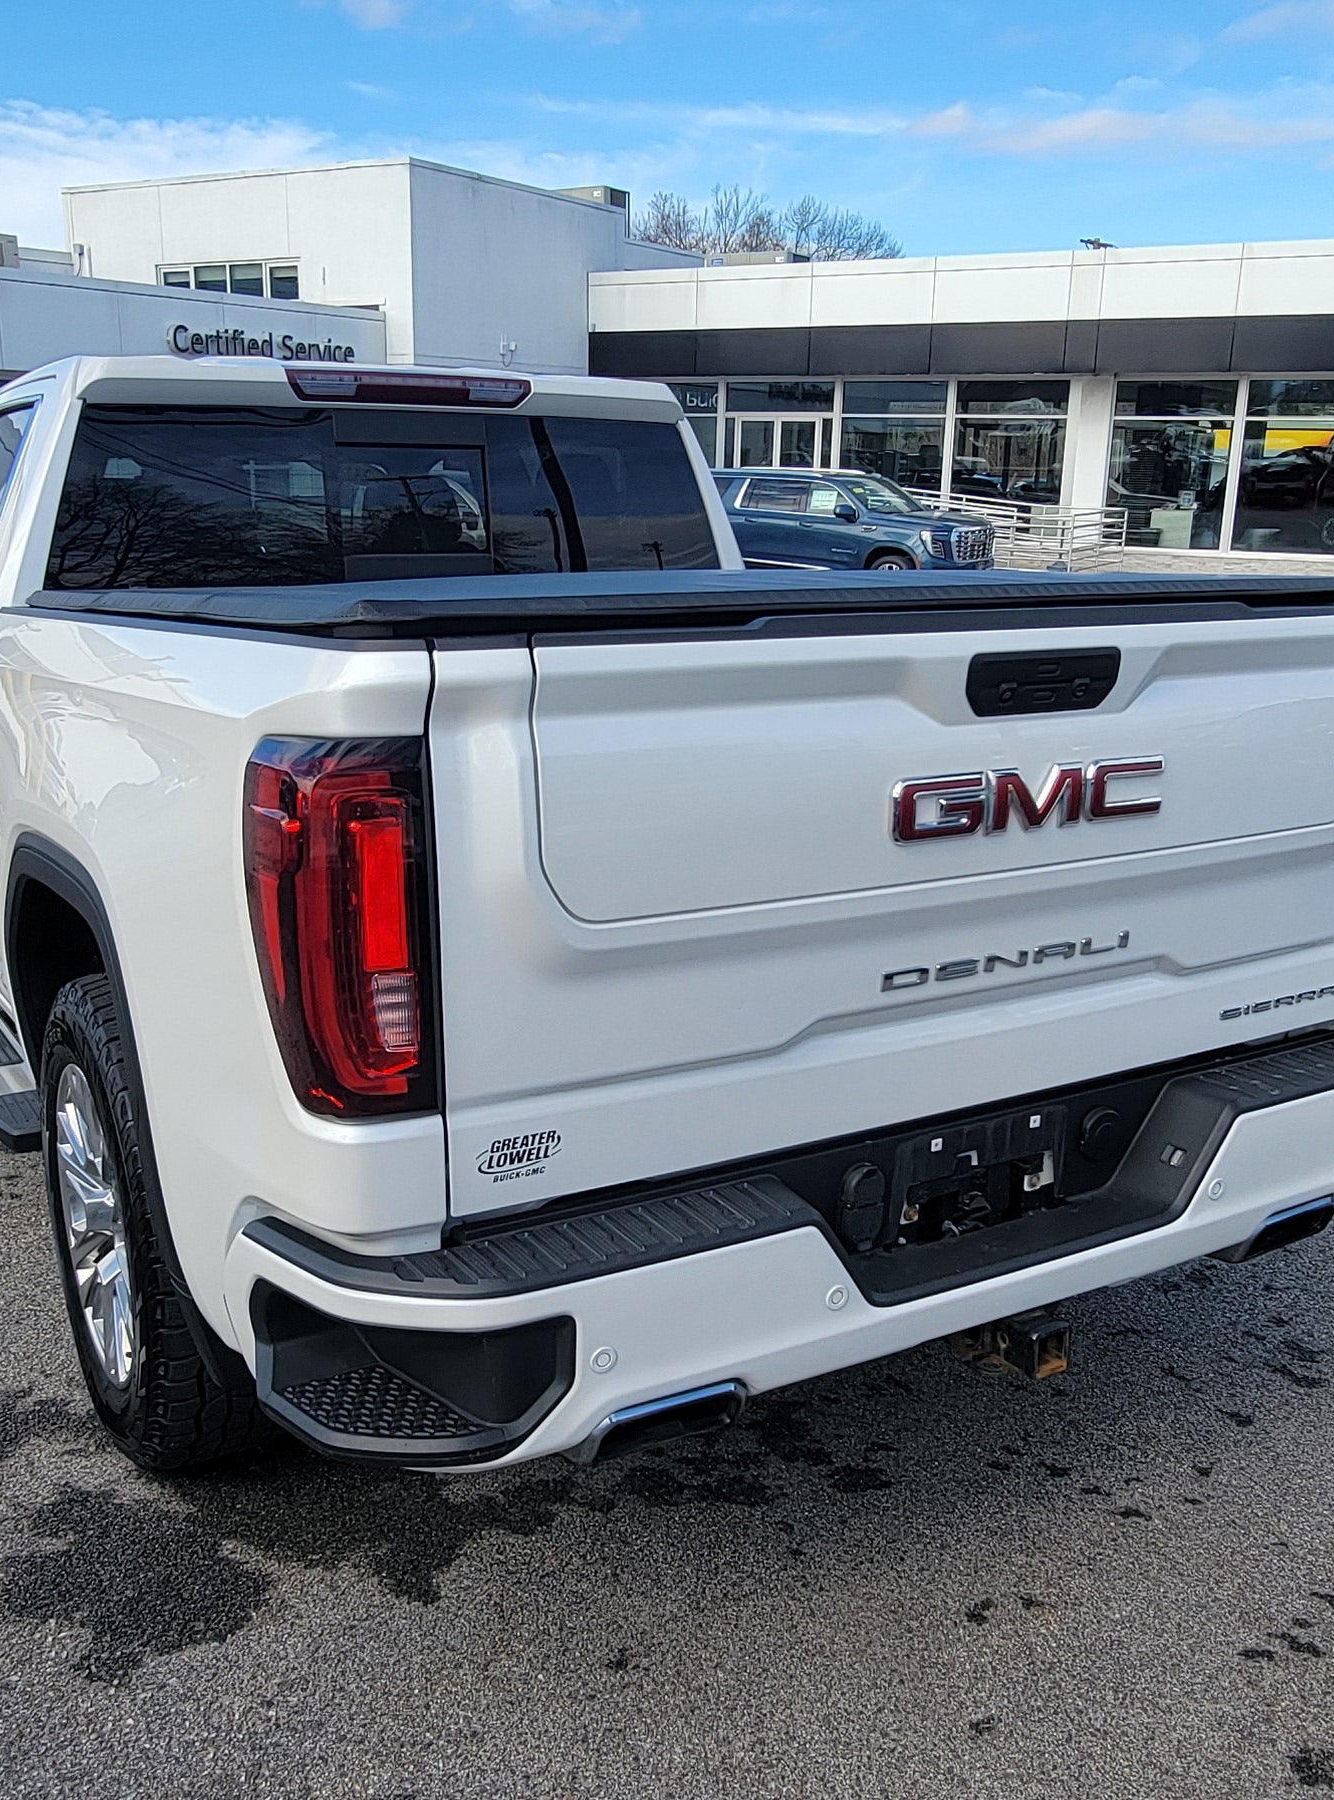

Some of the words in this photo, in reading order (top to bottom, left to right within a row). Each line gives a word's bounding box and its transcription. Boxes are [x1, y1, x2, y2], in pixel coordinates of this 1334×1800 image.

[168, 323, 273, 358] Certified
[279, 334, 355, 363] Service
[890, 754, 1165, 846] GMC
[879, 929, 1130, 992] DENALI
[486, 1144, 551, 1170] LOWELL
[489, 1129, 557, 1154] GREATER
